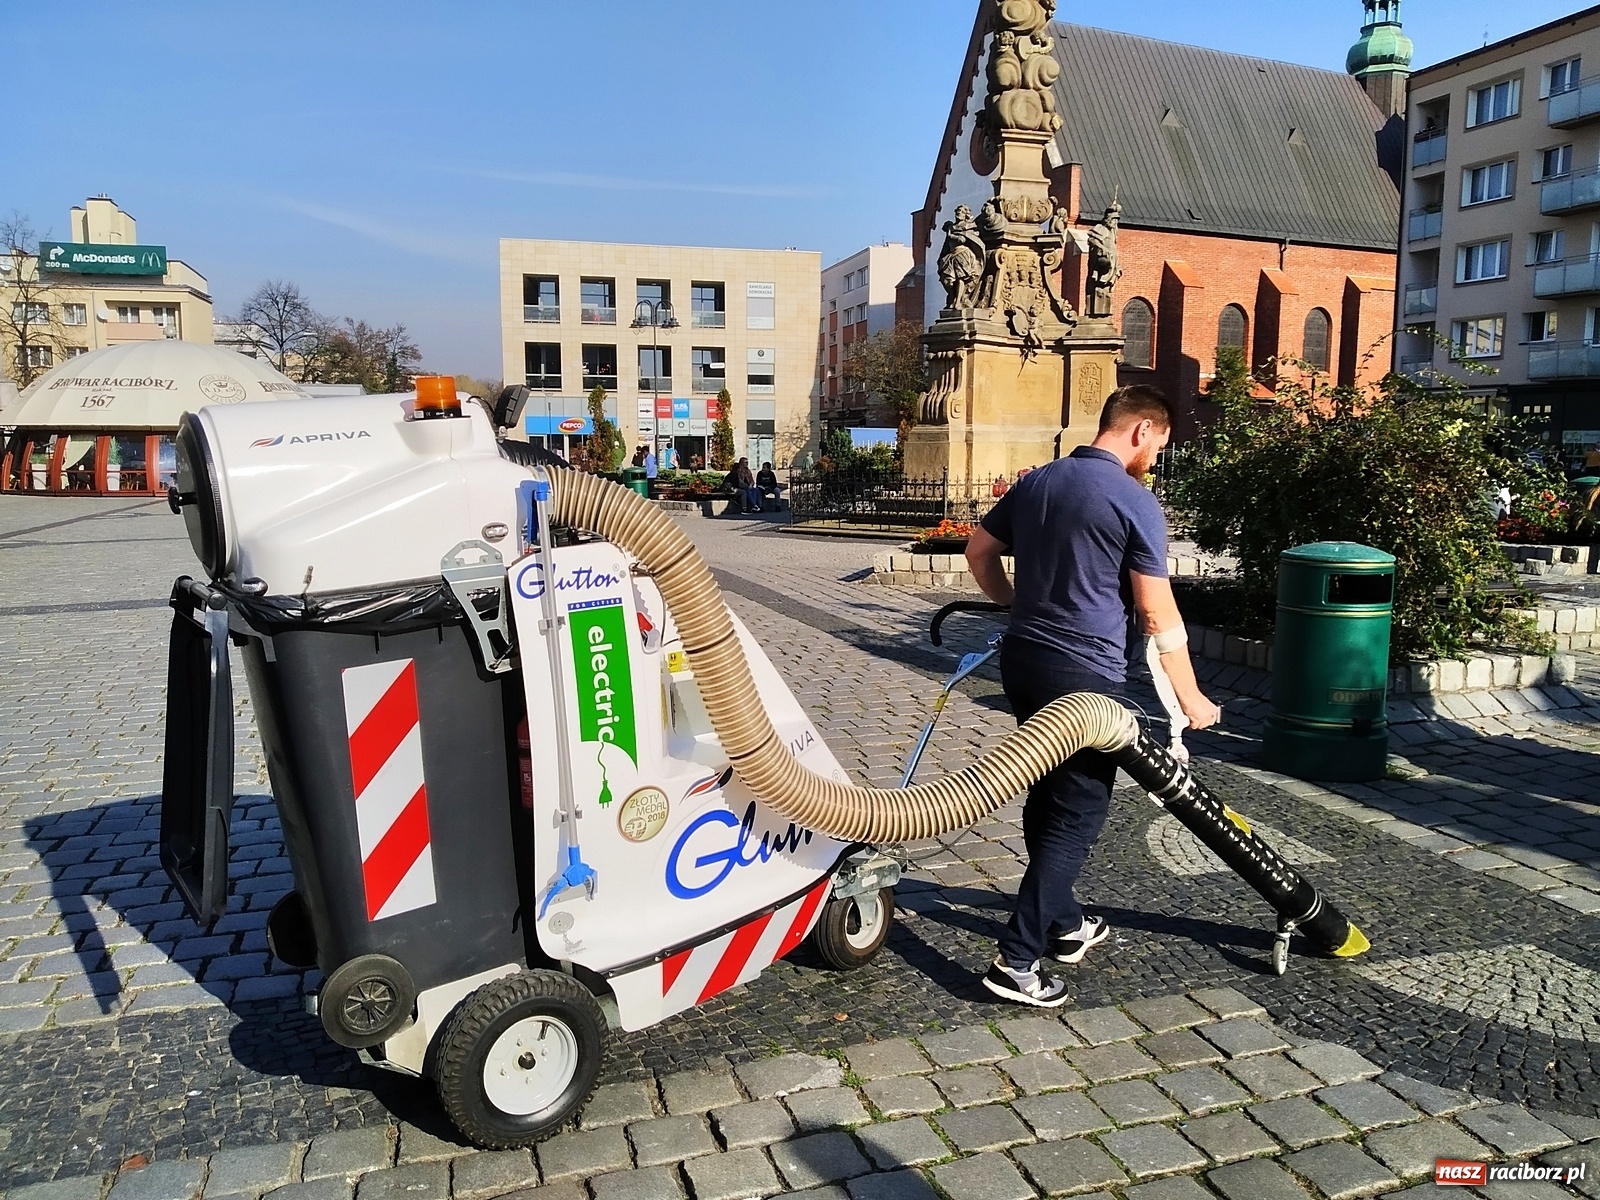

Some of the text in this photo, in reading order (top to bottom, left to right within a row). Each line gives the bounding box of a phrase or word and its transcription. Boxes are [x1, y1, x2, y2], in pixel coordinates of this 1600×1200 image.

[72, 253, 136, 264] McDonald's
[48, 376, 178, 390] BROWAR RACIBÓRZ
[80, 394, 116, 409] 1567
[289, 430, 372, 445] APRIVA
[591, 598, 620, 606] CITIES
[588, 625, 620, 743] electric
[630, 793, 660, 809] ZŁOTY
[635, 801, 667, 817] MEDAL
[647, 811, 666, 823] 2018
